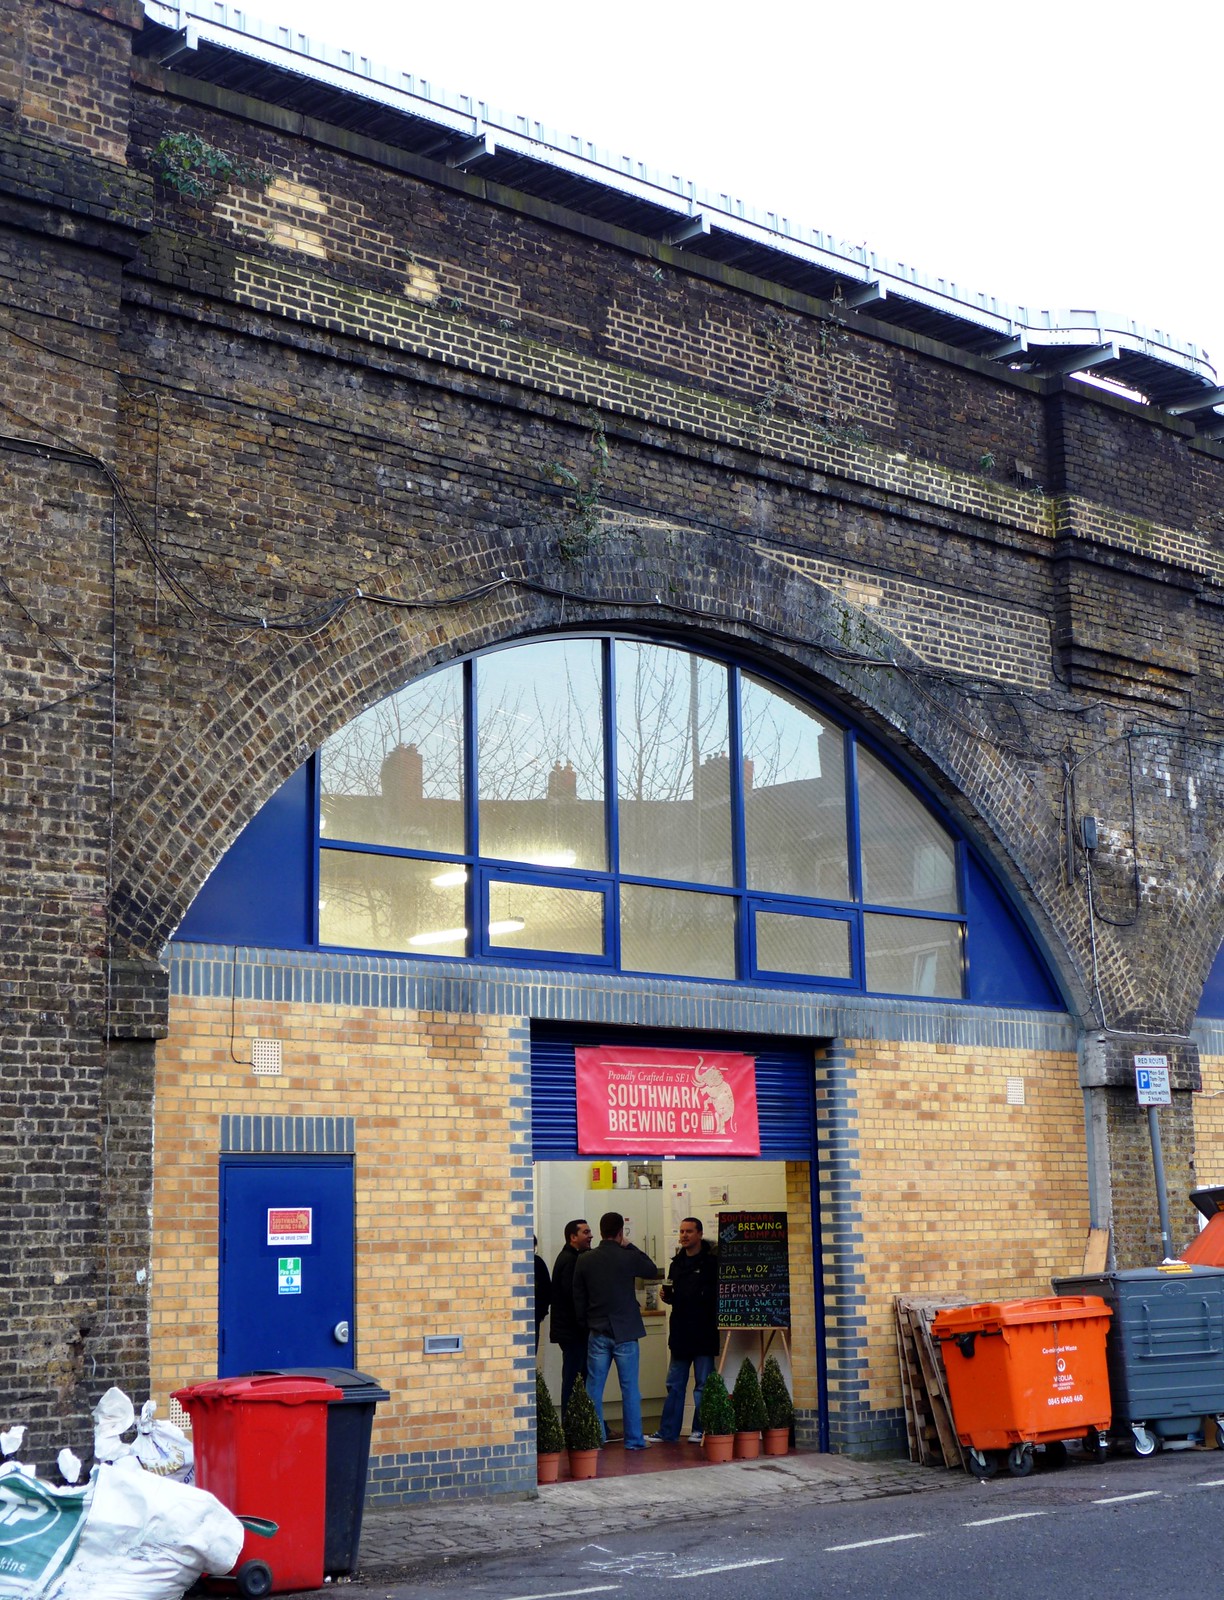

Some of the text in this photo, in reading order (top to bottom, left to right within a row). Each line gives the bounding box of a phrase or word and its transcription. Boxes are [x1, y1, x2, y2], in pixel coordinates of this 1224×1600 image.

[608, 1070, 690, 1084] Proudly Crafted in SE1
[1140, 1072, 1148, 1088] P
[607, 1083, 701, 1109] SOUTHWARK
[608, 1109, 676, 1133] BREWING
[721, 1214, 774, 1222] SOUTHWARK
[738, 1222, 783, 1232] BREWING
[719, 1265, 737, 1274] LPA
[719, 1283, 776, 1293] BERMONDSEY
[719, 1298, 784, 1308] BITTER SWEET
[718, 1314, 742, 1322] GOLD
[1042, 1346, 1064, 1354] Co-migled
[1048, 1397, 1060, 1405] 0845
